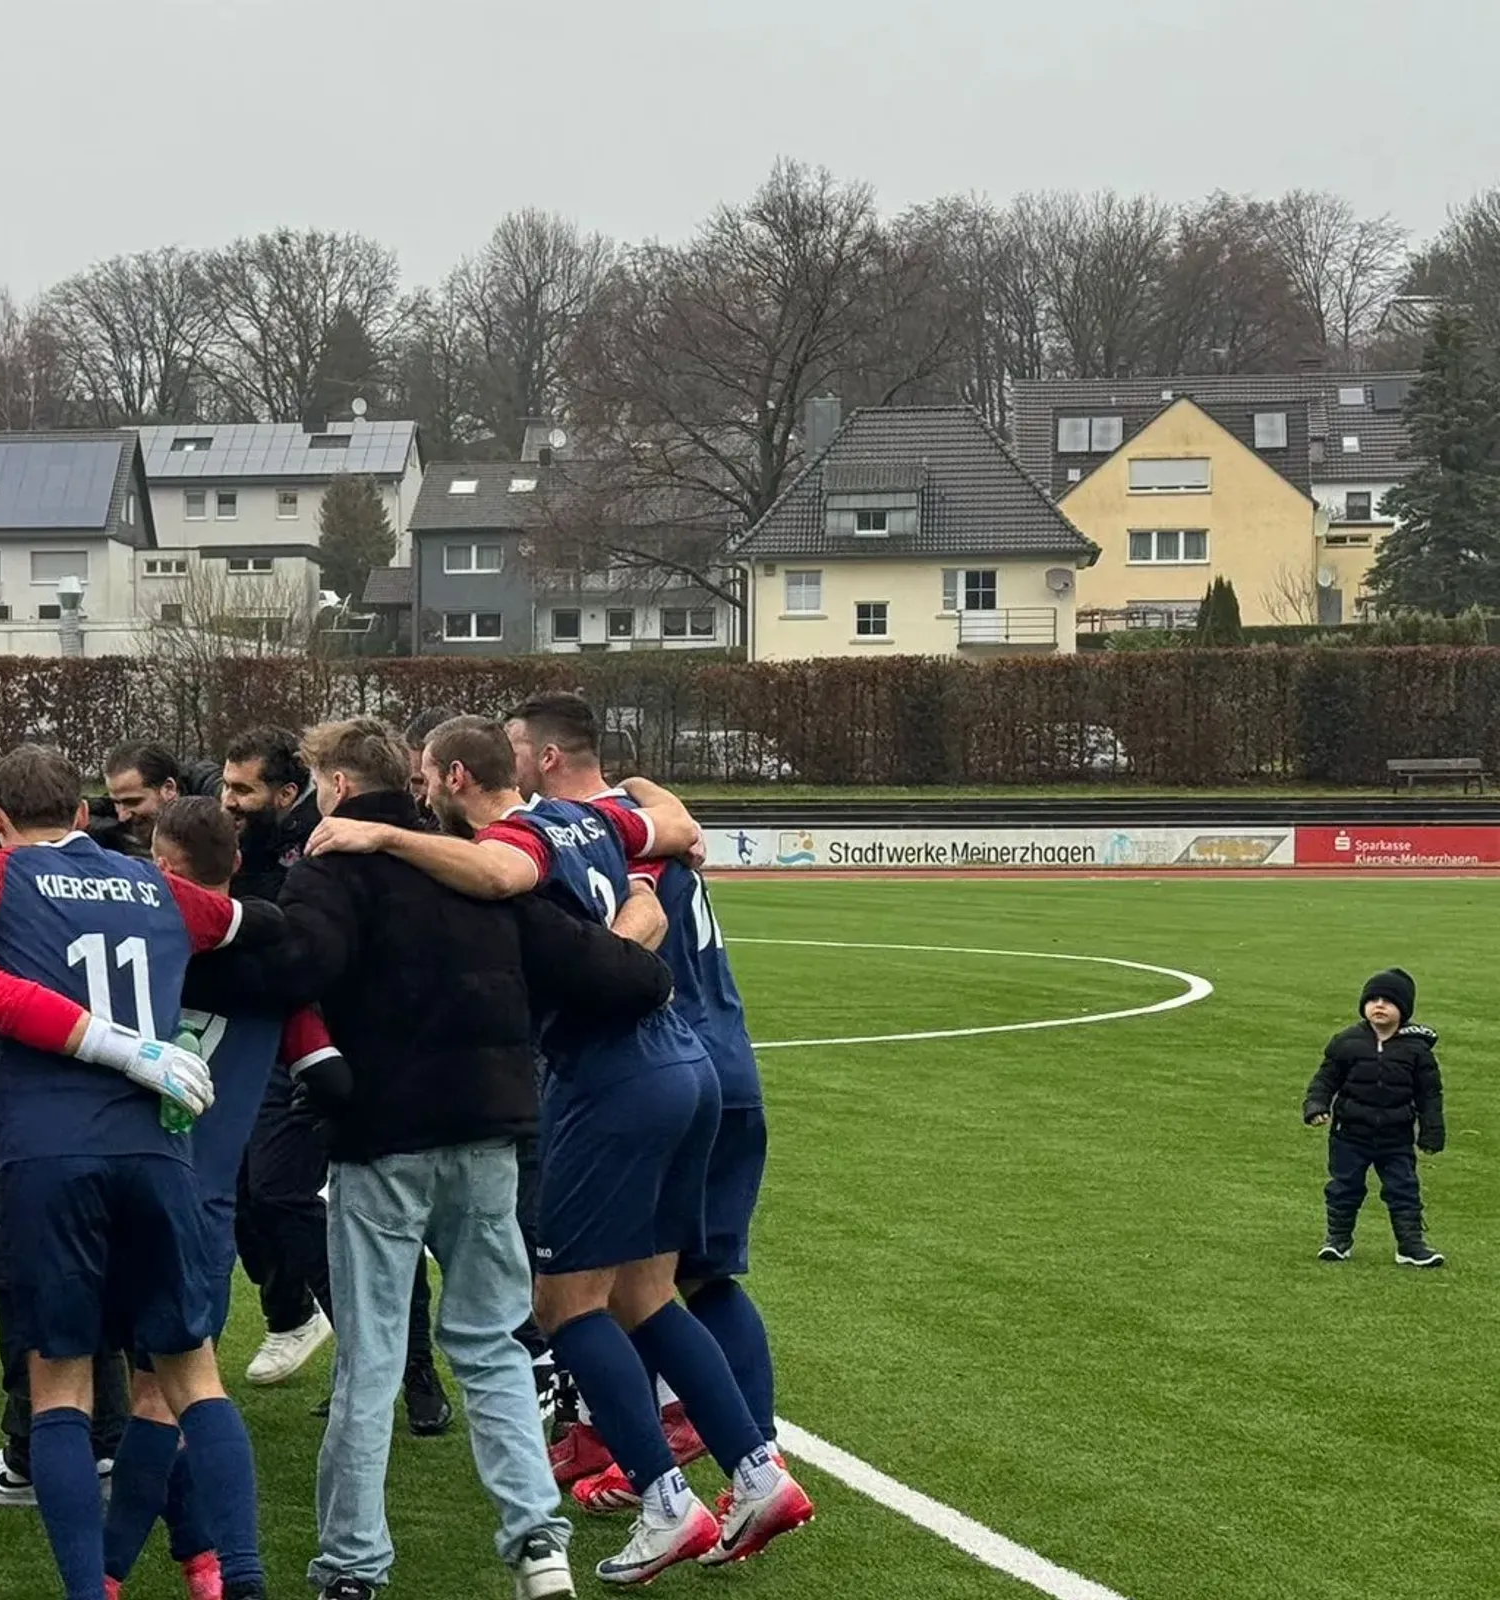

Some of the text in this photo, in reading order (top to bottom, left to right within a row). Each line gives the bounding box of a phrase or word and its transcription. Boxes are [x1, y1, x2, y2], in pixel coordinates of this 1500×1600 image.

[828, 841, 1096, 865] Stadtwerke Meinerzhagen
[1354, 839, 1412, 852] Sparkasse
[35, 874, 161, 908] KIERSPER SC
[67, 932, 157, 1041] 11
